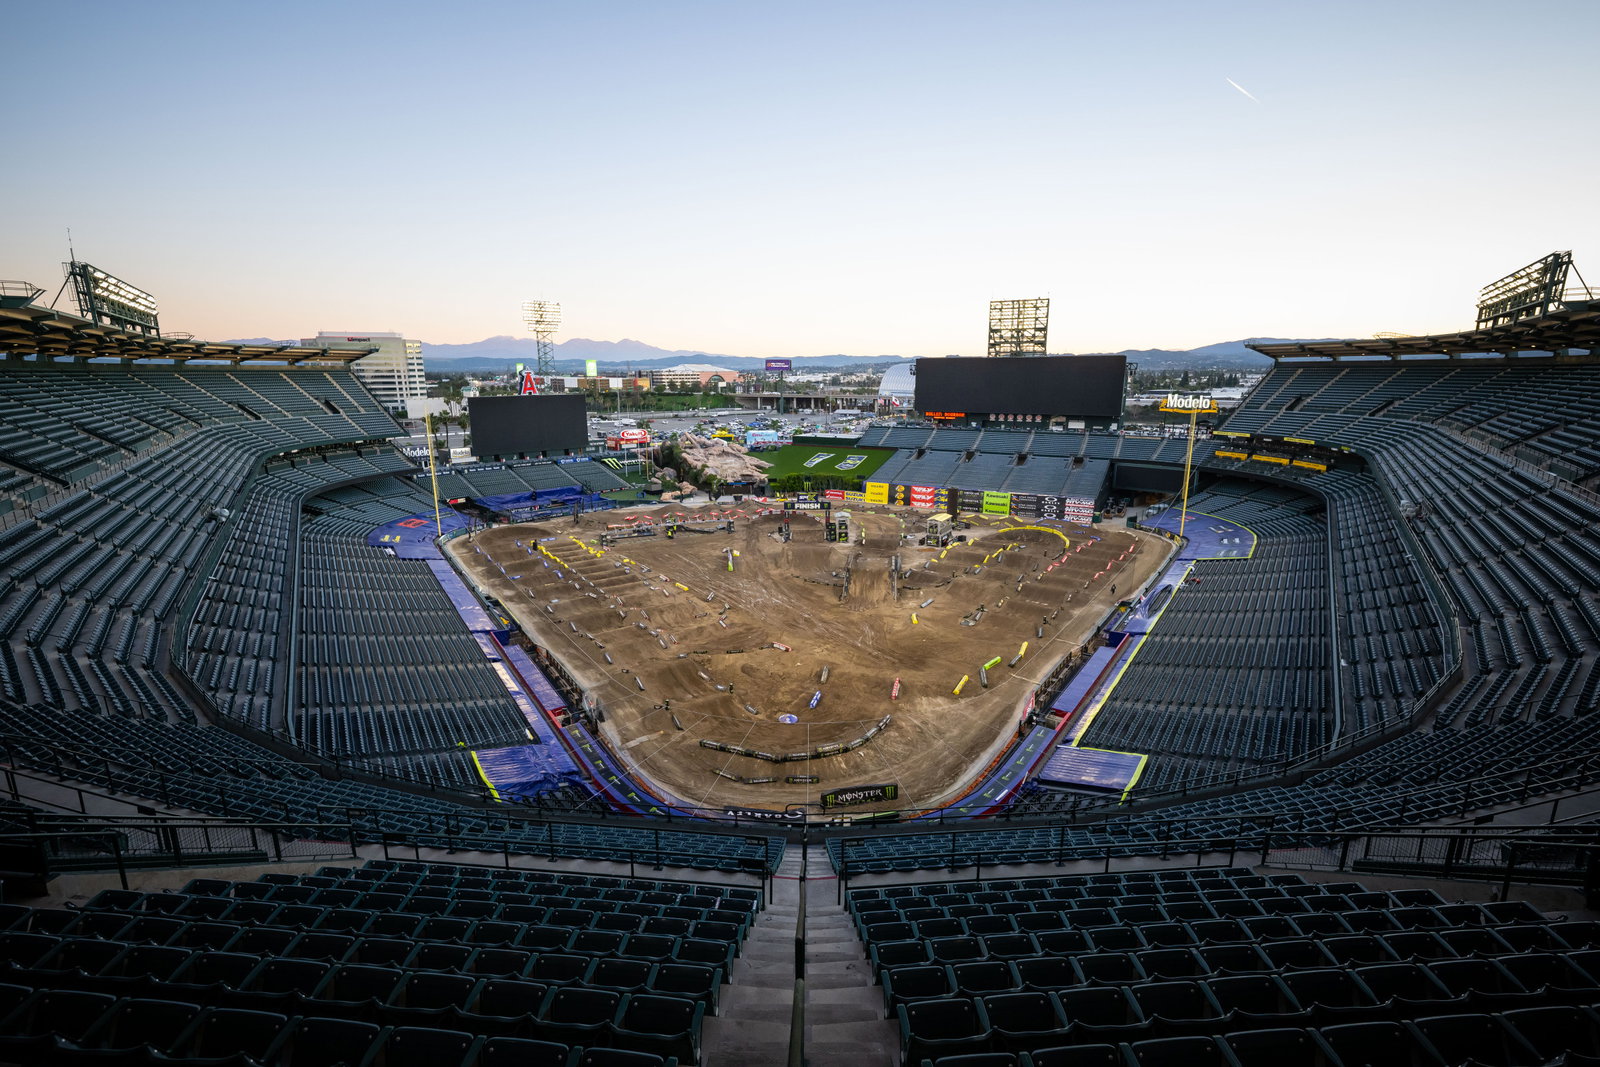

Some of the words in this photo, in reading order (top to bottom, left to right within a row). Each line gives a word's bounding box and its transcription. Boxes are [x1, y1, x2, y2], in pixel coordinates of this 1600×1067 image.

[1167, 394, 1210, 409] Modelo
[402, 447, 430, 457] Modelo
[838, 789, 882, 802] MONSTER
